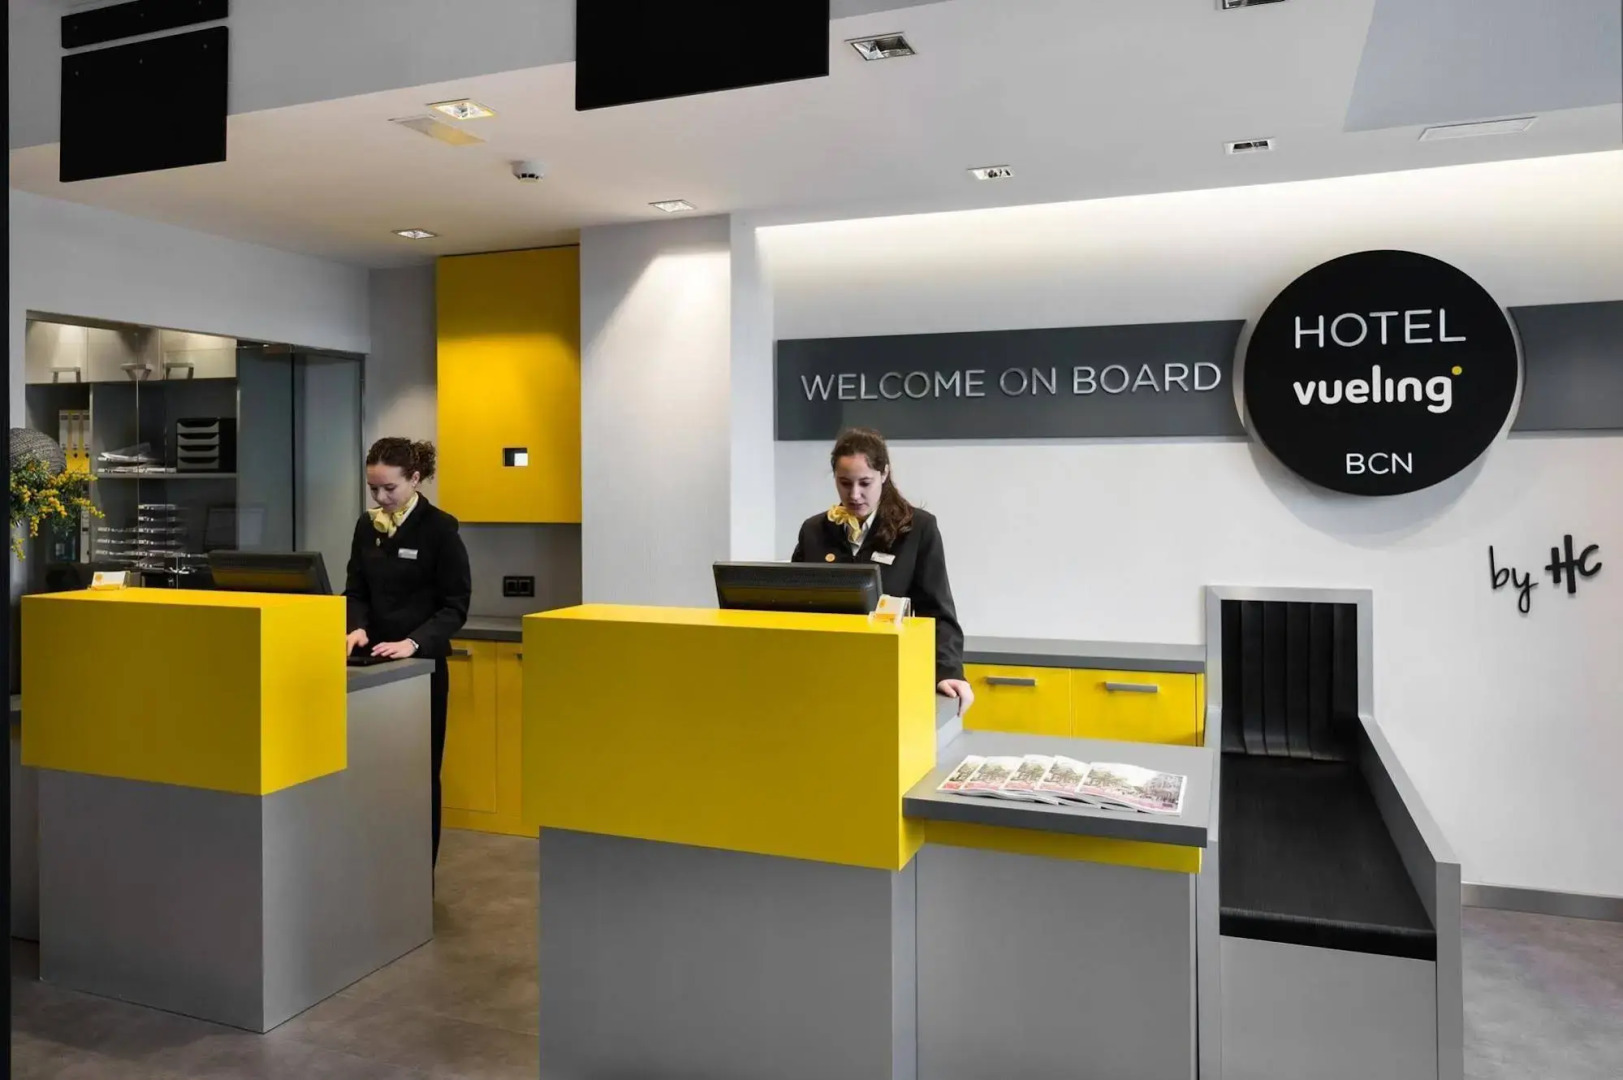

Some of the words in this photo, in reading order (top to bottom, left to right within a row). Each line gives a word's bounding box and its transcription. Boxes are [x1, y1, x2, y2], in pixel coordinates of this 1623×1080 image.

[1293, 308, 1468, 349] HOTEL
[800, 368, 987, 401] WELCOME
[999, 366, 1057, 396] ON
[1072, 361, 1223, 395] BOARD
[1292, 364, 1463, 414] vueling
[1346, 452, 1414, 476] BCN
[1489, 544, 1539, 614] by
[1544, 533, 1603, 595] HC
